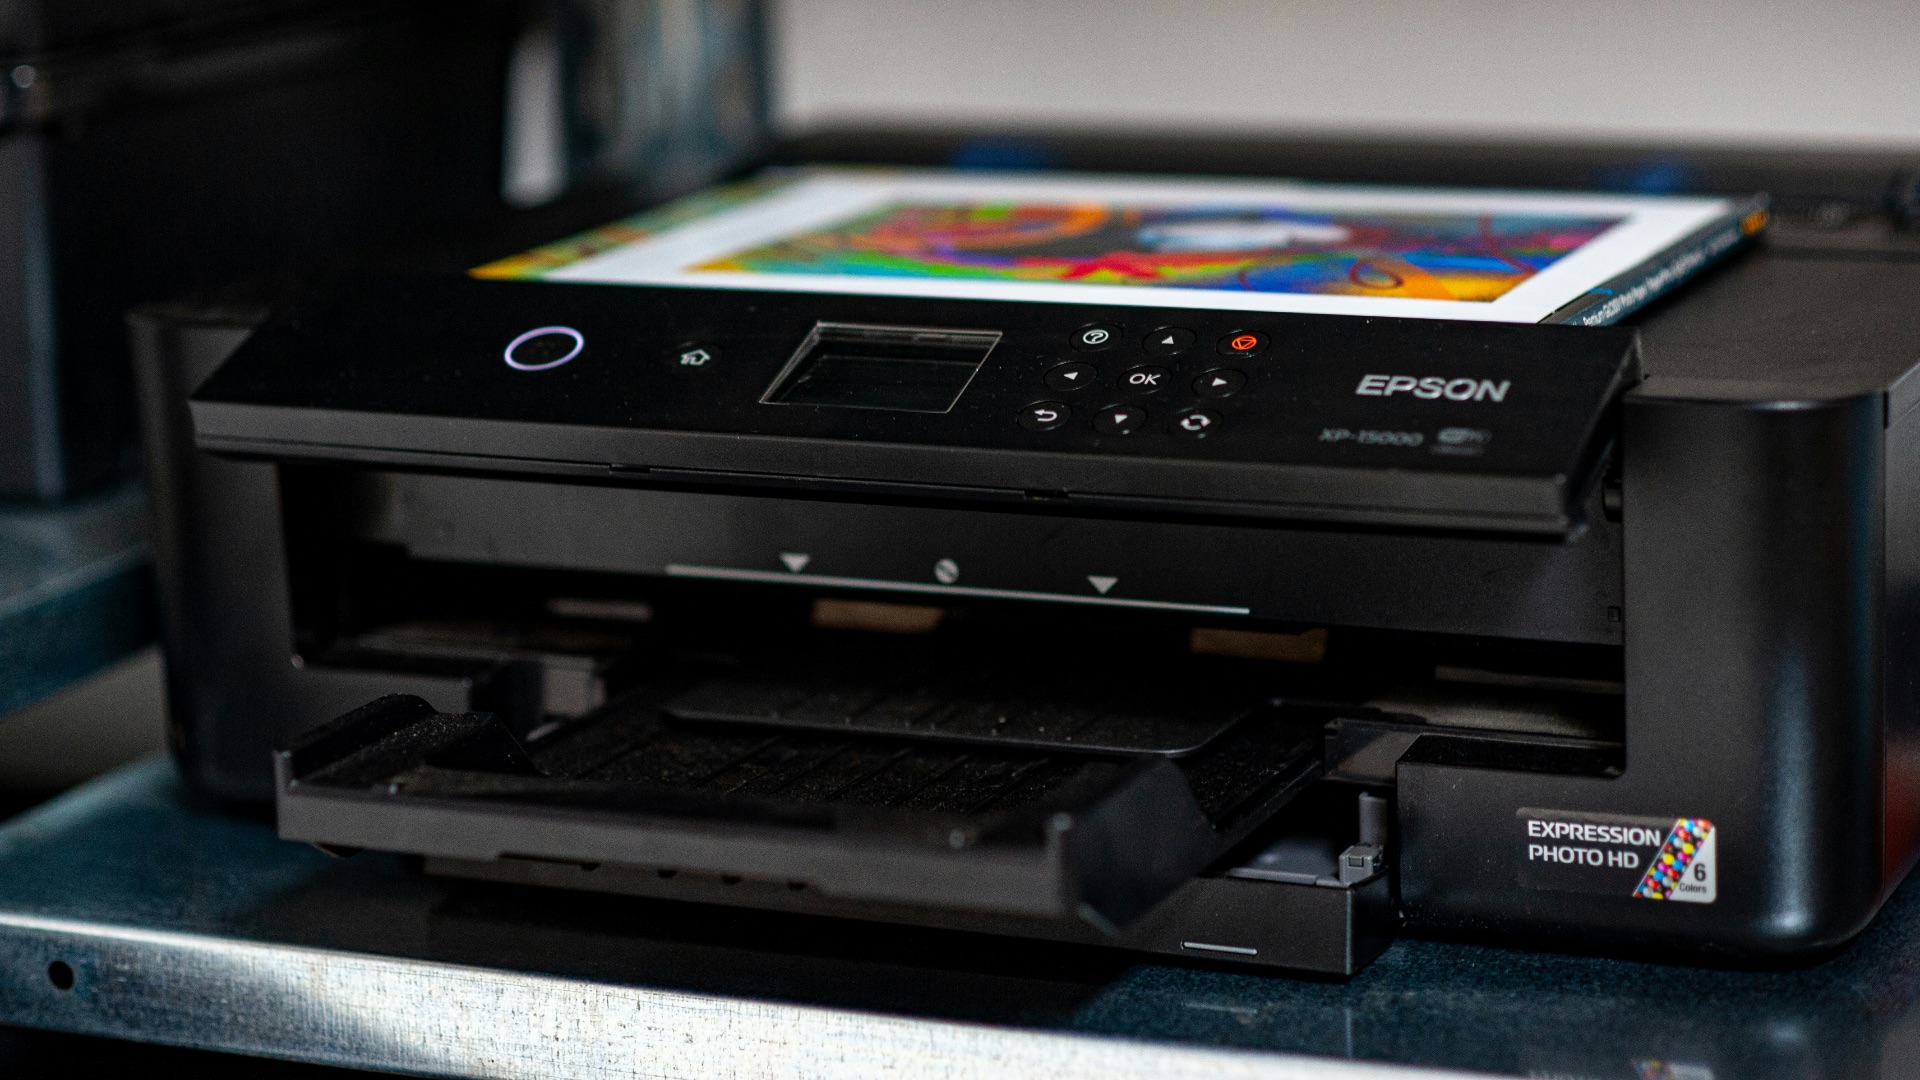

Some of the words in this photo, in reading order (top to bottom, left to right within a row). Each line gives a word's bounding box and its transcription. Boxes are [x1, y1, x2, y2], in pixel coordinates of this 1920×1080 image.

[1129, 373, 1161, 385] OK
[1355, 374, 1511, 402] EPSON
[1528, 820, 1661, 846] EXPRESSION
[1529, 844, 1604, 866] PHOTO
[1608, 851, 1640, 869] HD
[1693, 863, 1707, 882] 6
[1678, 882, 1707, 894] Colors
